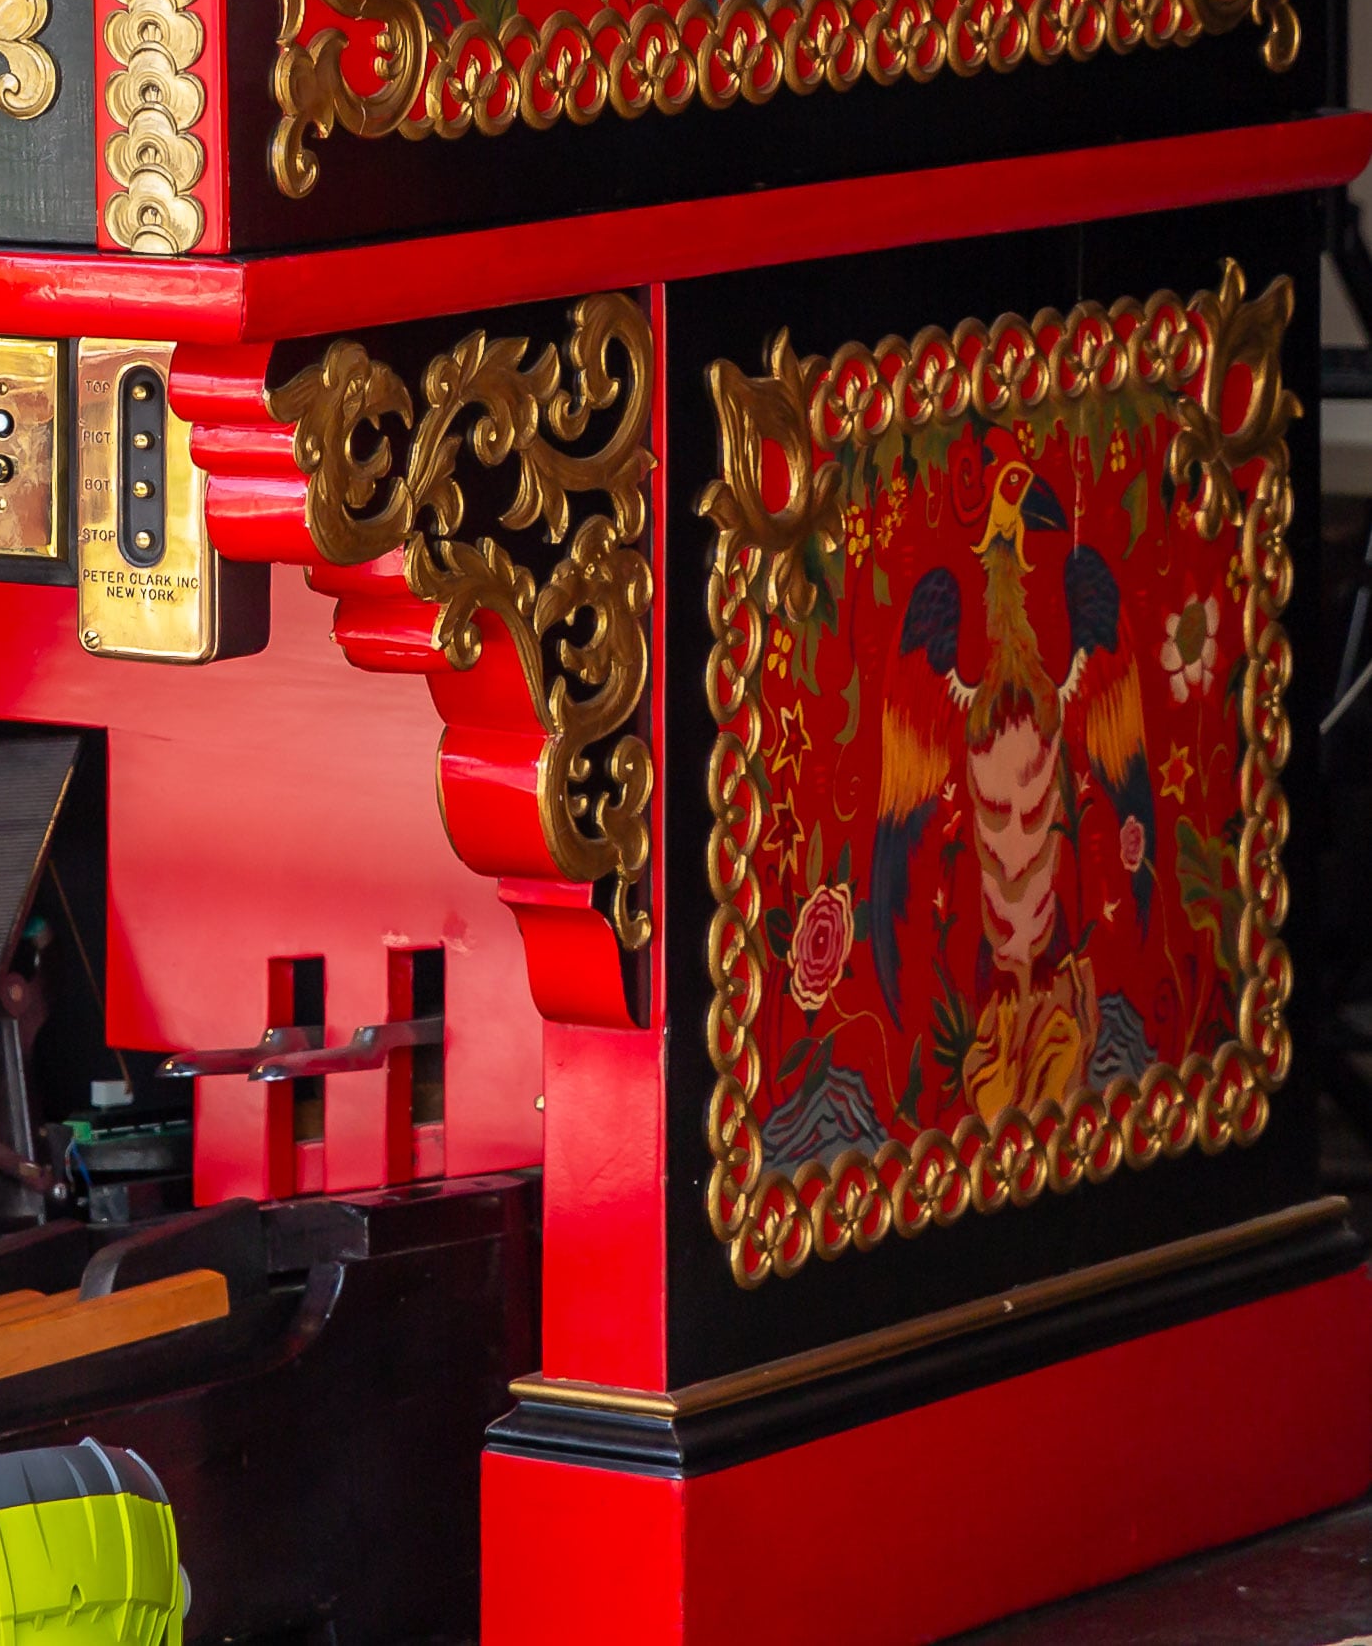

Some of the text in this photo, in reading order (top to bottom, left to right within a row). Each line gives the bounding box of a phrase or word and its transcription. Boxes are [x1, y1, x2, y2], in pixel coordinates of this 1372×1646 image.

[85, 380, 111, 395] TOP
[82, 431, 114, 445] PICT.
[84, 478, 113, 492] BOT.
[82, 528, 117, 542] STOP
[83, 569, 125, 585] PETER
[129, 572, 173, 587] CLARK
[106, 586, 136, 600] NEW
